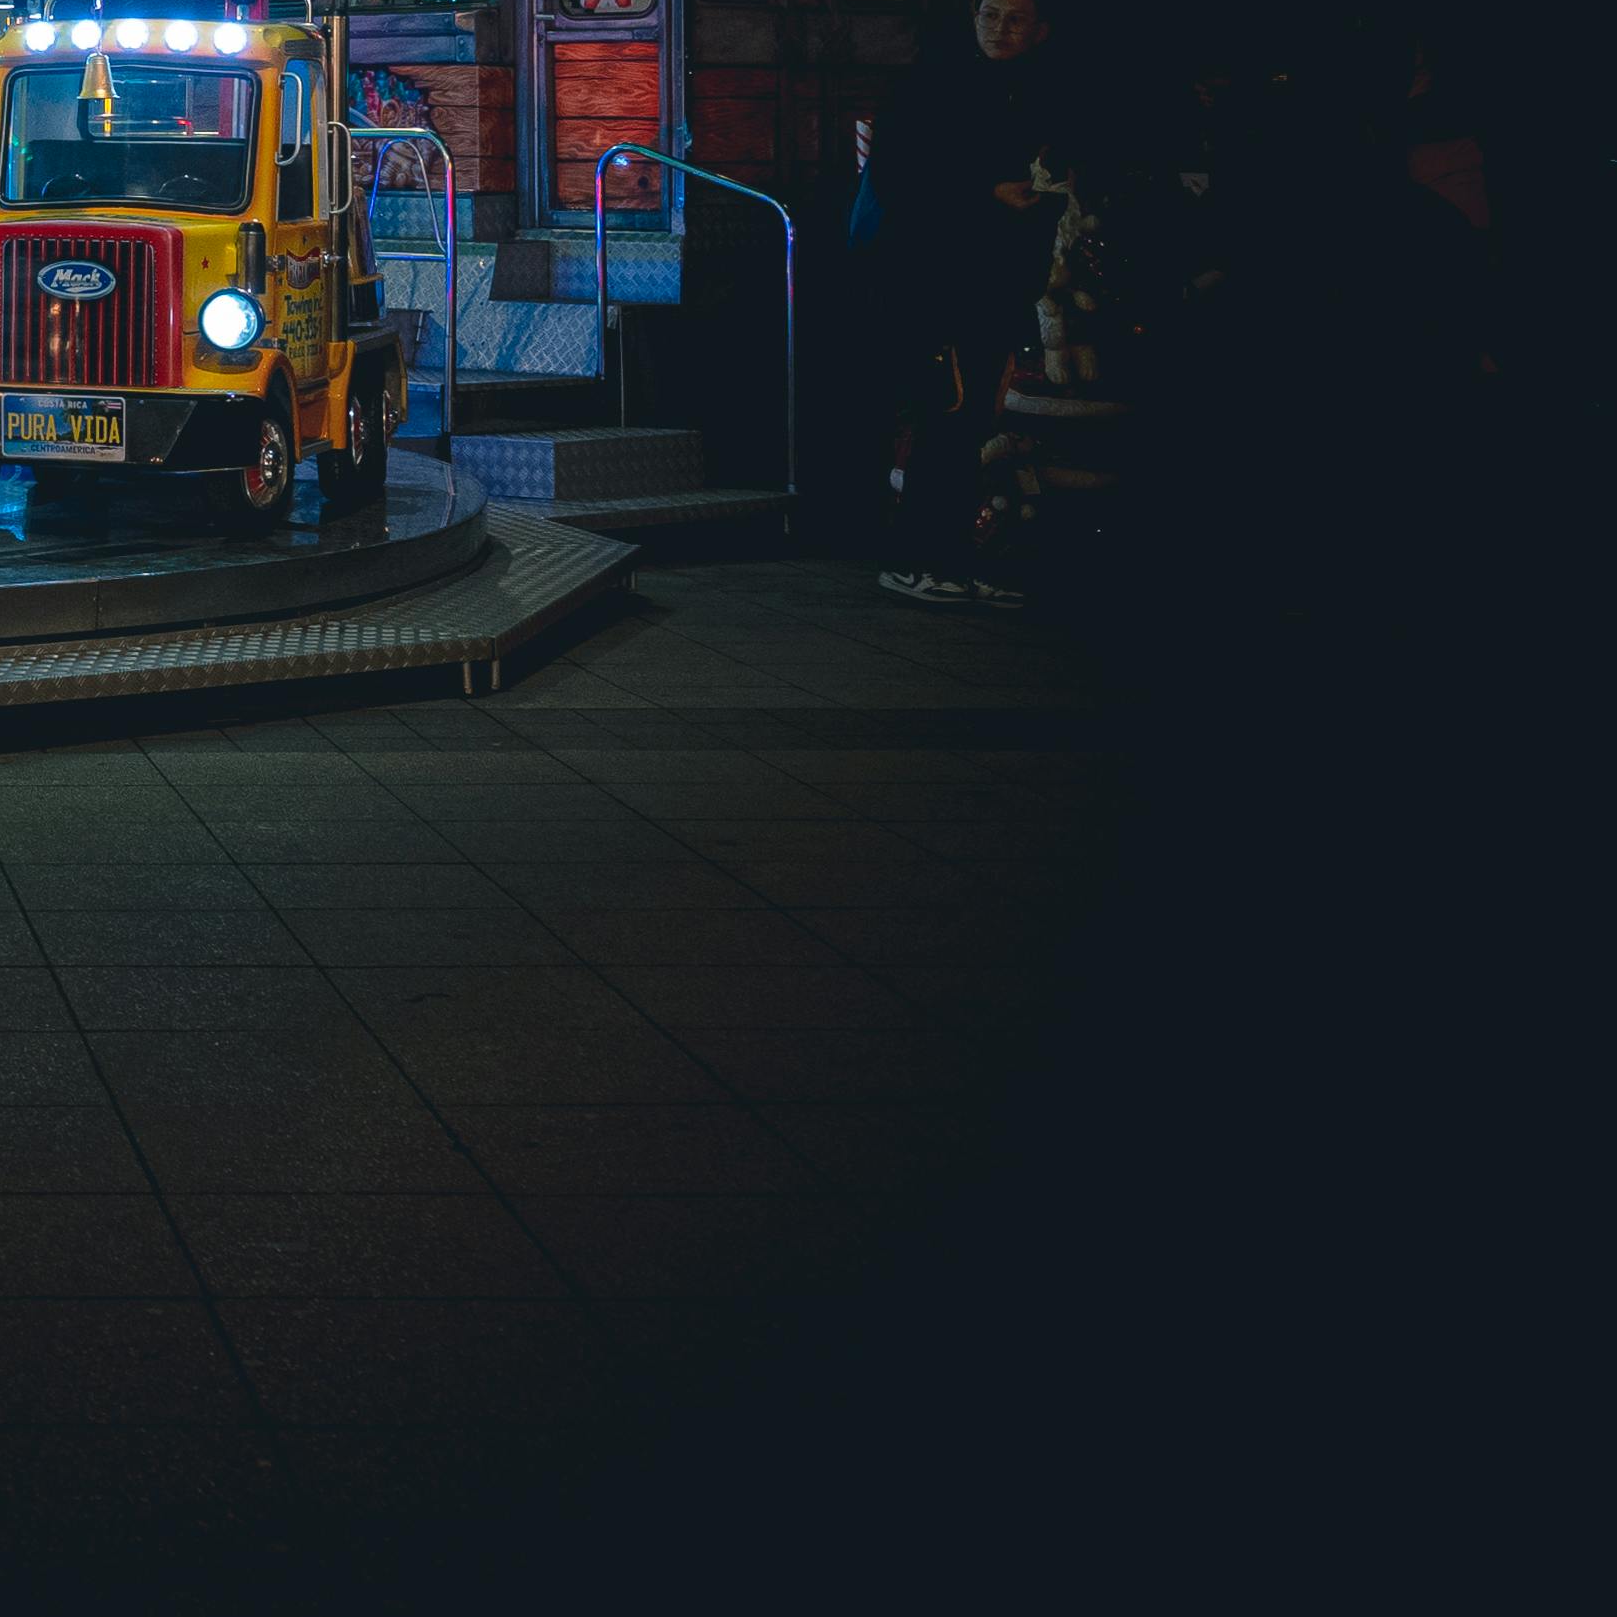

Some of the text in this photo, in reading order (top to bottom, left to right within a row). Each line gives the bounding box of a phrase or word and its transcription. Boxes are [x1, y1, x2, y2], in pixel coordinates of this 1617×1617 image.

[50, 267, 103, 290] Mack
[37, 399, 88, 410] COSTA RICA
[7, 412, 122, 445] PURA VIDA
[30, 443, 97, 455] CENTROAMERICA
